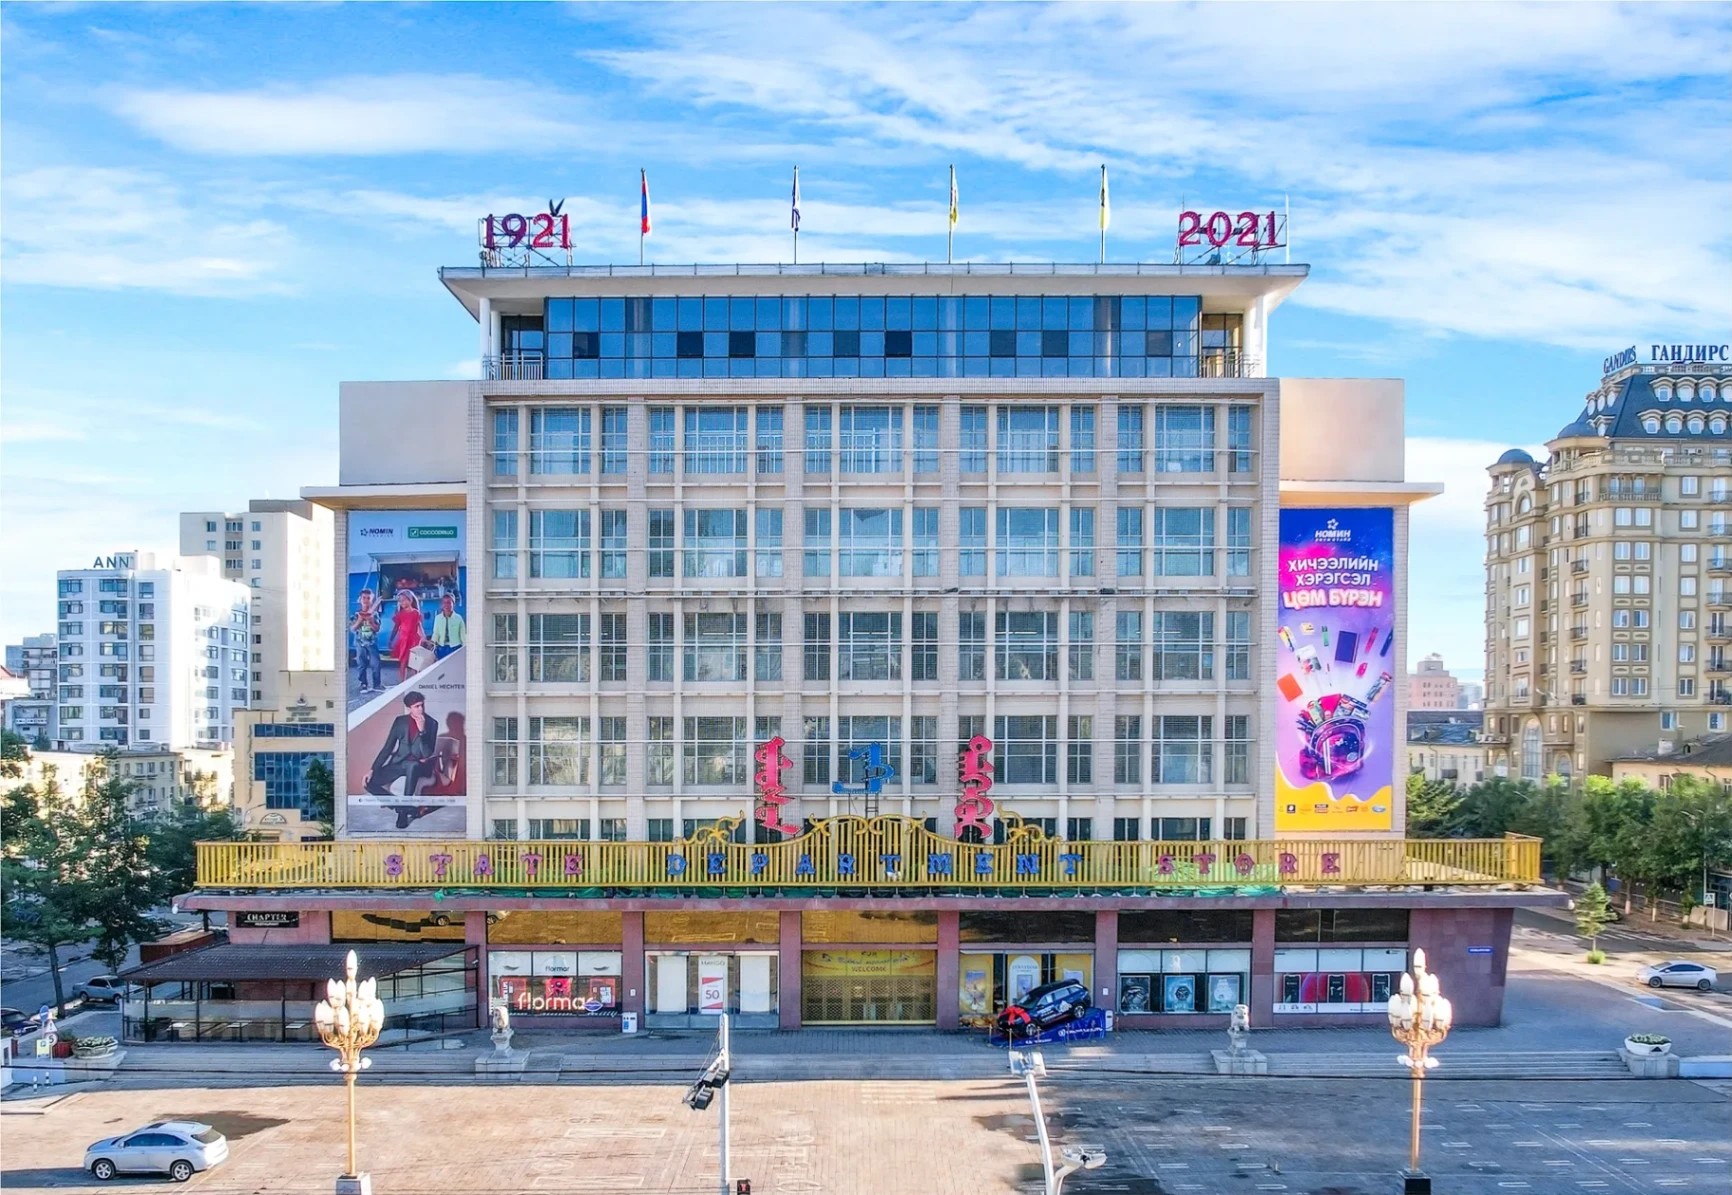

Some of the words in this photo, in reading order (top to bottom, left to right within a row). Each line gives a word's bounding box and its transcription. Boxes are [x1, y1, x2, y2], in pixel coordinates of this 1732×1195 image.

[482, 213, 569, 249] 1921
[1179, 211, 1278, 247] 2021
[1651, 345, 1729, 363] ГАНДИРС
[1315, 530, 1351, 538] НОМИН
[1287, 555, 1379, 572] ХИЧЭЭЛИЙН
[1296, 572, 1371, 586] ХЭРЭГСЭЛ
[384, 853, 583, 876] STATE
[666, 853, 1082, 876] DEPARTMENT
[1158, 852, 1341, 875] STORE
[247, 913, 287, 921] CHAPTER
[705, 989, 720, 1000] 50
